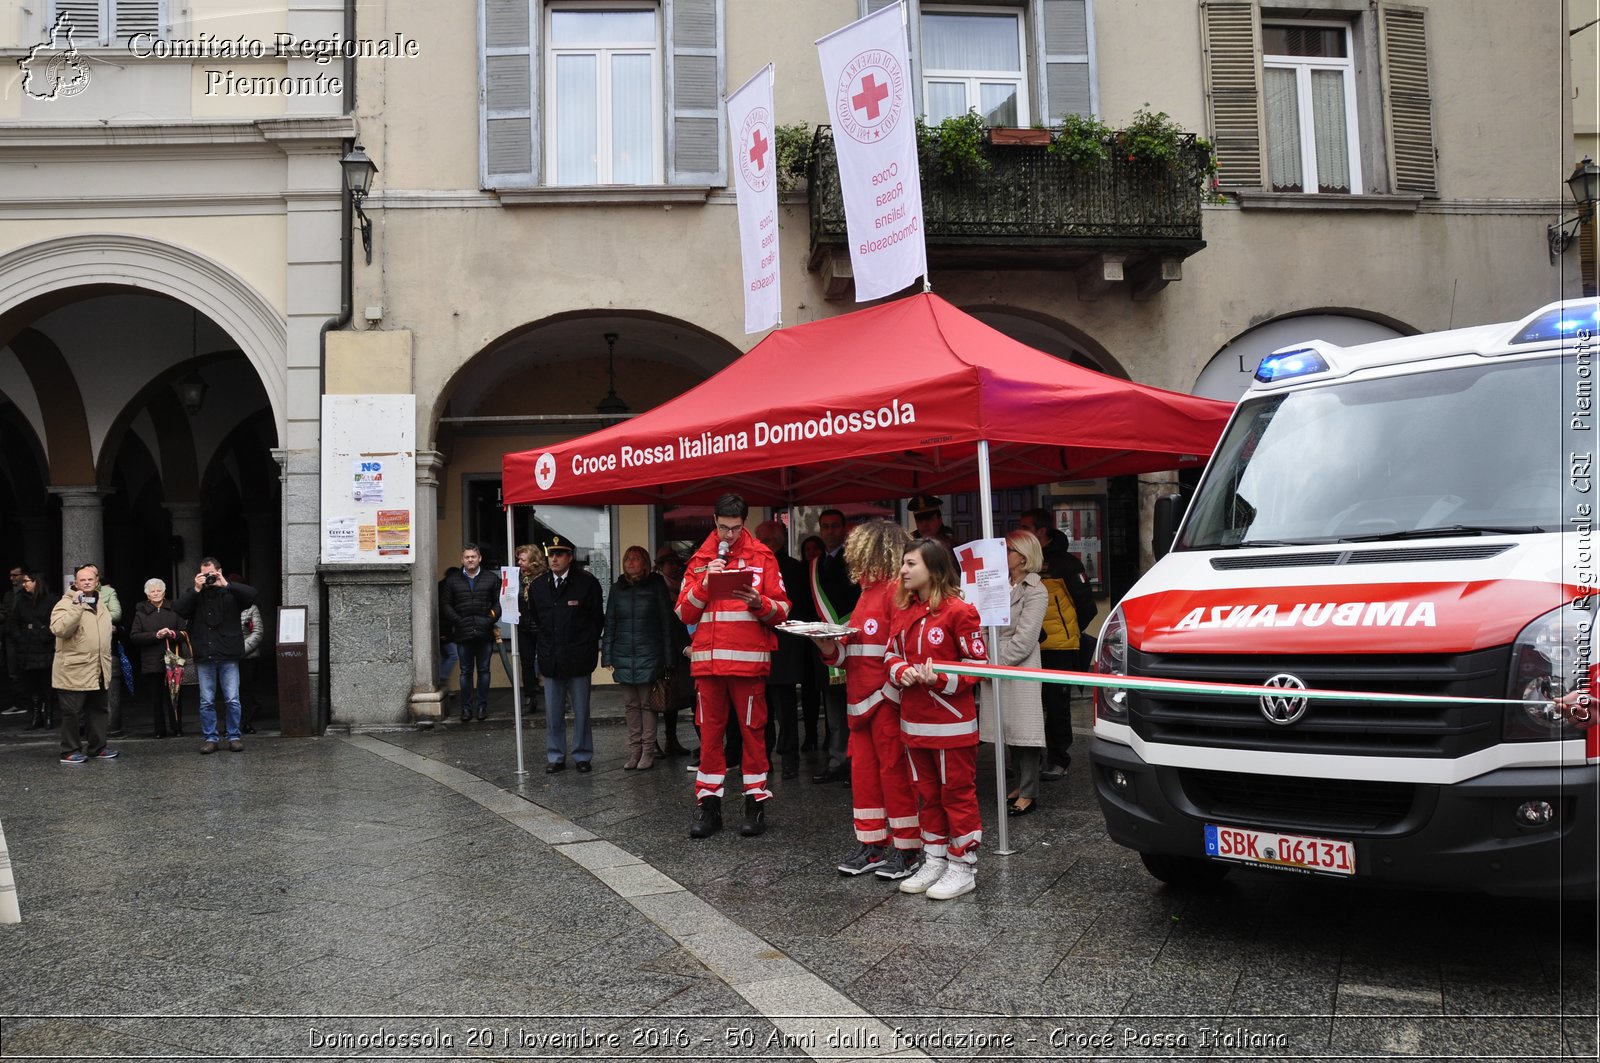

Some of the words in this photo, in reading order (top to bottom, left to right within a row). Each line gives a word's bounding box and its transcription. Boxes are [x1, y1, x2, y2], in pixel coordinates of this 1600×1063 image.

[572, 453, 617, 476] Croce
[621, 442, 674, 468] Rossa
[679, 432, 748, 460] Italiana
[754, 398, 916, 448] Domodossola
[361, 462, 382, 472] NO
[1220, 830, 1260, 858] SBK
[1278, 838, 1350, 870] 06131
